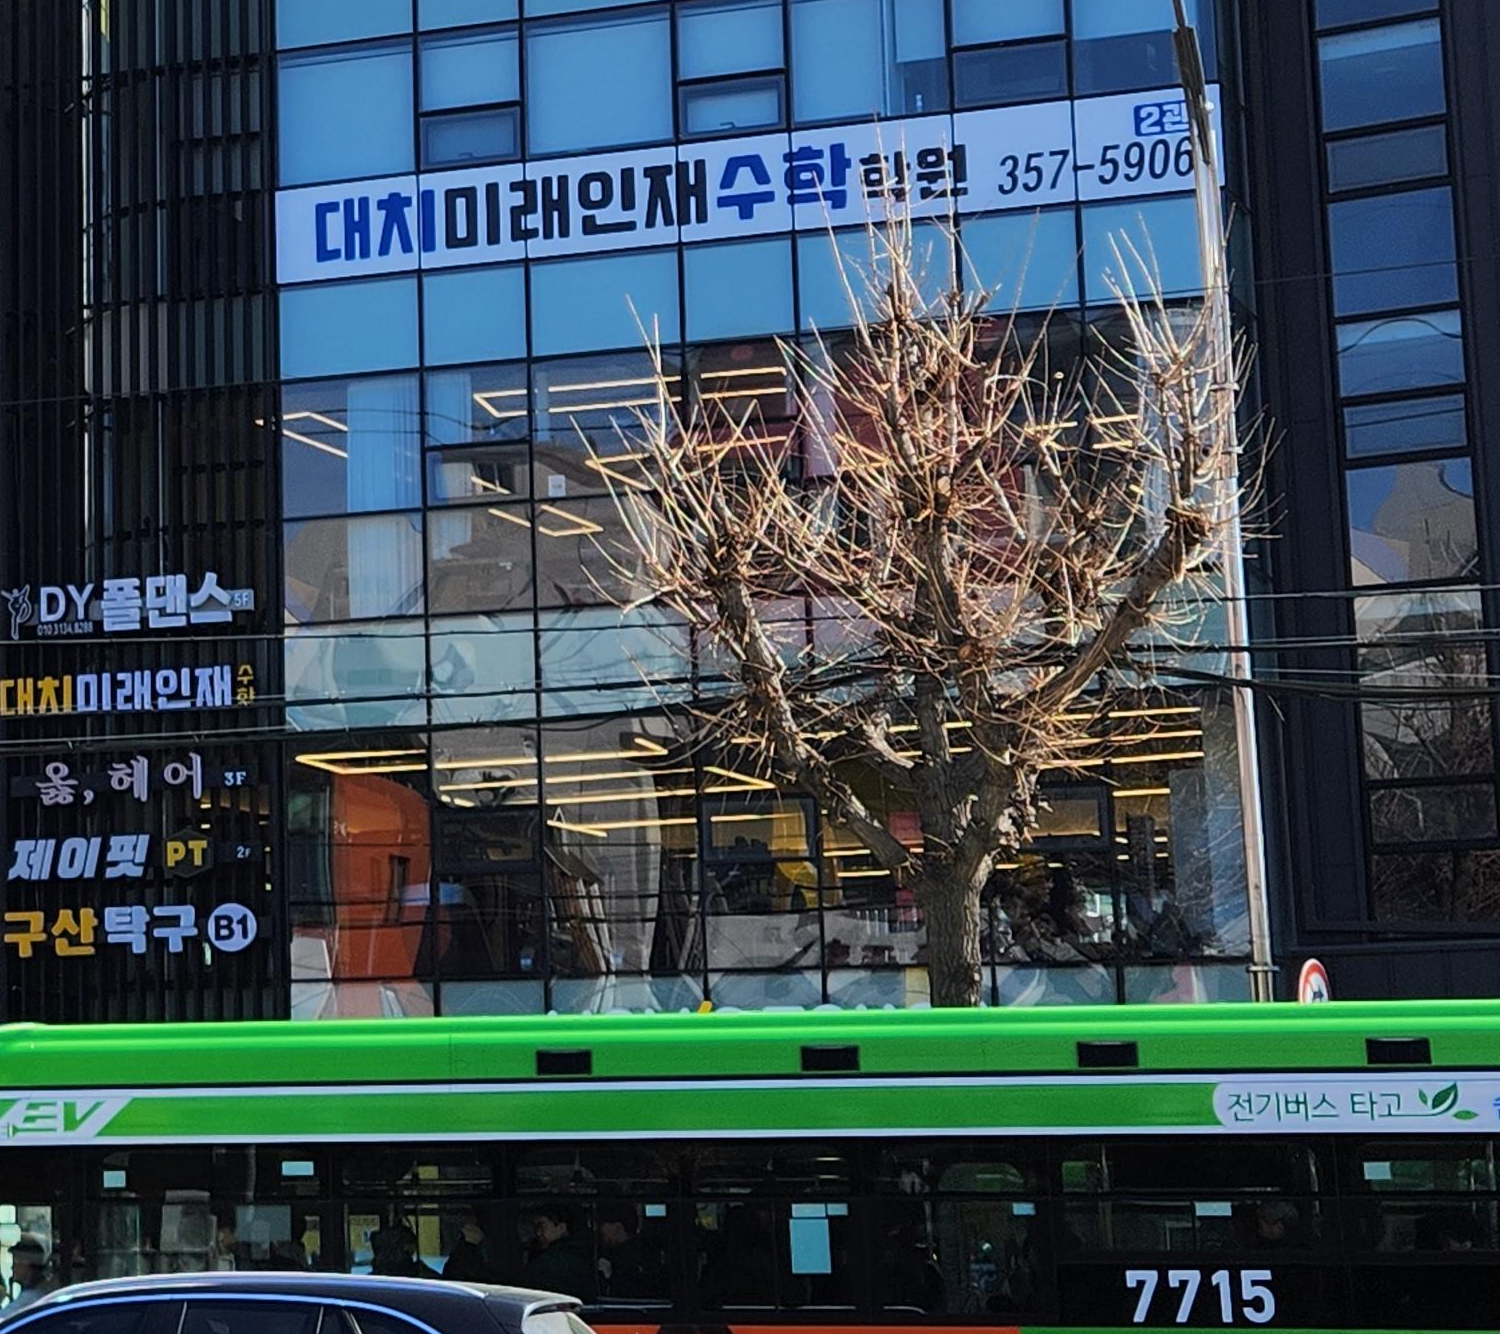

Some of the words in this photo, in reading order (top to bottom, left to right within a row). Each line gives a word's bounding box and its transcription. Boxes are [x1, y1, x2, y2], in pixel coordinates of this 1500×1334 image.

[997, 137, 1194, 198] 357-5906
[39, 584, 94, 623] DY
[102, 571, 233, 633] 폴댄스
[233, 593, 249, 609] 5F
[0, 664, 232, 717] 대치미래인재
[107, 752, 203, 803] 헤어
[224, 771, 247, 786] 3F
[7, 834, 151, 881] 제이핏
[166, 839, 208, 867] PT
[213, 914, 250, 942] B1
[7, 1101, 105, 1139] EV
[1227, 1092, 1340, 1123] 전기버스
[1350, 1092, 1402, 1122] 타고
[1126, 1270, 1275, 1323] 7715
